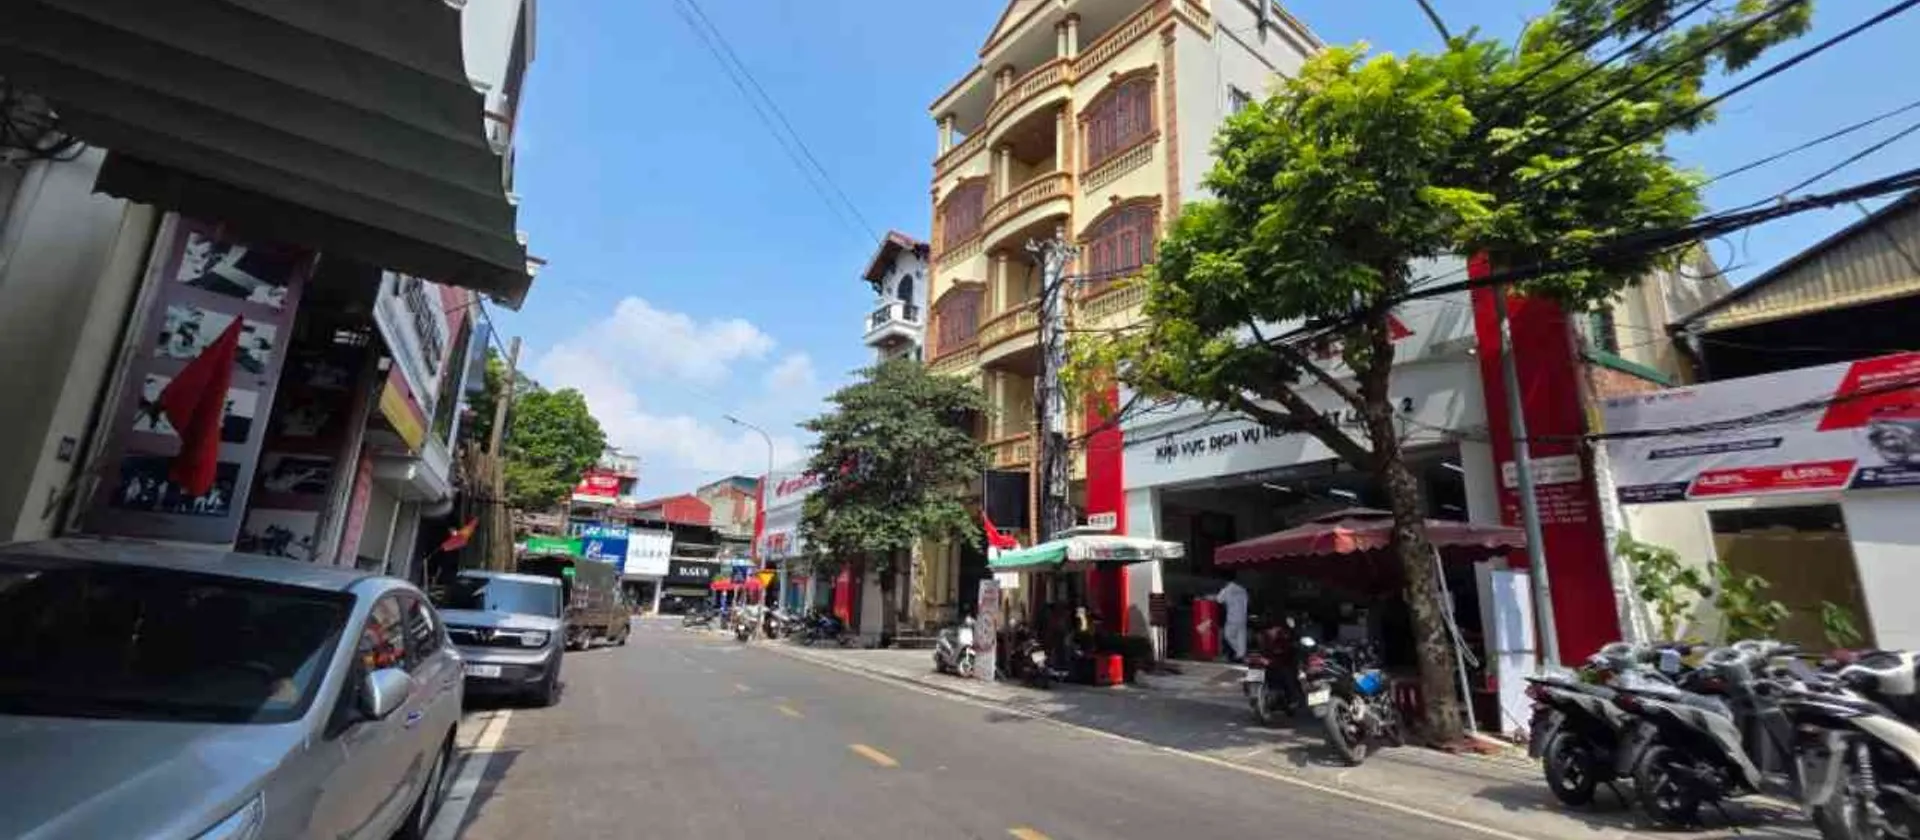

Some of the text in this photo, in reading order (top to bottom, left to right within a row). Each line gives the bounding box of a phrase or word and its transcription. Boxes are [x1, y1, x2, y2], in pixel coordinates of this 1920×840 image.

[1209, 431, 1239, 451] DỊCH
[1242, 426, 1261, 445] VỤ
[1402, 396, 1414, 412] 2
